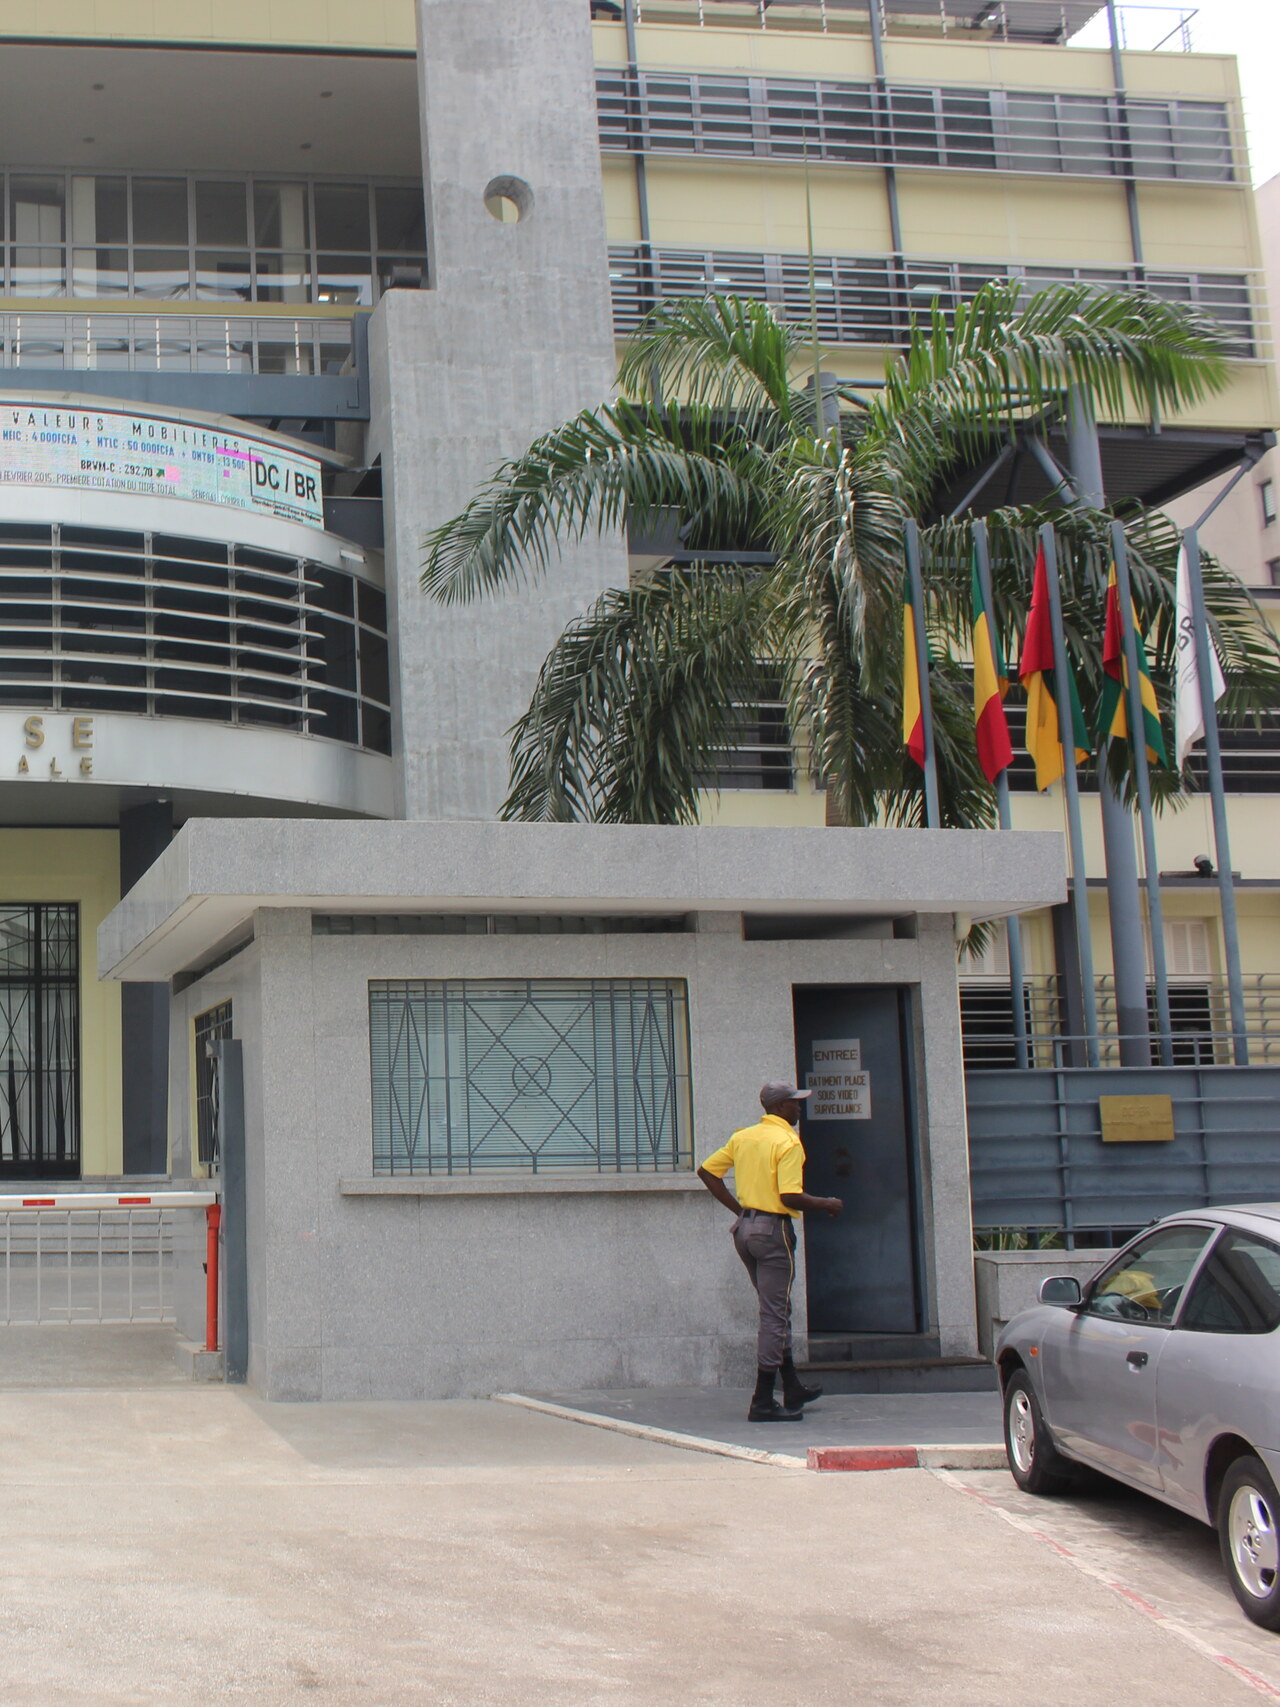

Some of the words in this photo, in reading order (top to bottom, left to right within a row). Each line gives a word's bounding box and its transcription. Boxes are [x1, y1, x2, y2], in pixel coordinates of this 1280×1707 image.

[13, 411, 104, 431] VALEURS
[132, 422, 240, 453] MOBILIERES
[80, 459, 115, 473] BRVM-C
[808, 1075, 842, 1087] BATIMENT
[844, 1075, 866, 1086] PLACE
[817, 1090, 836, 1101] SOUS
[837, 1089, 858, 1100] VIDEO
[814, 1104, 862, 1115] SURVEILLANCE
